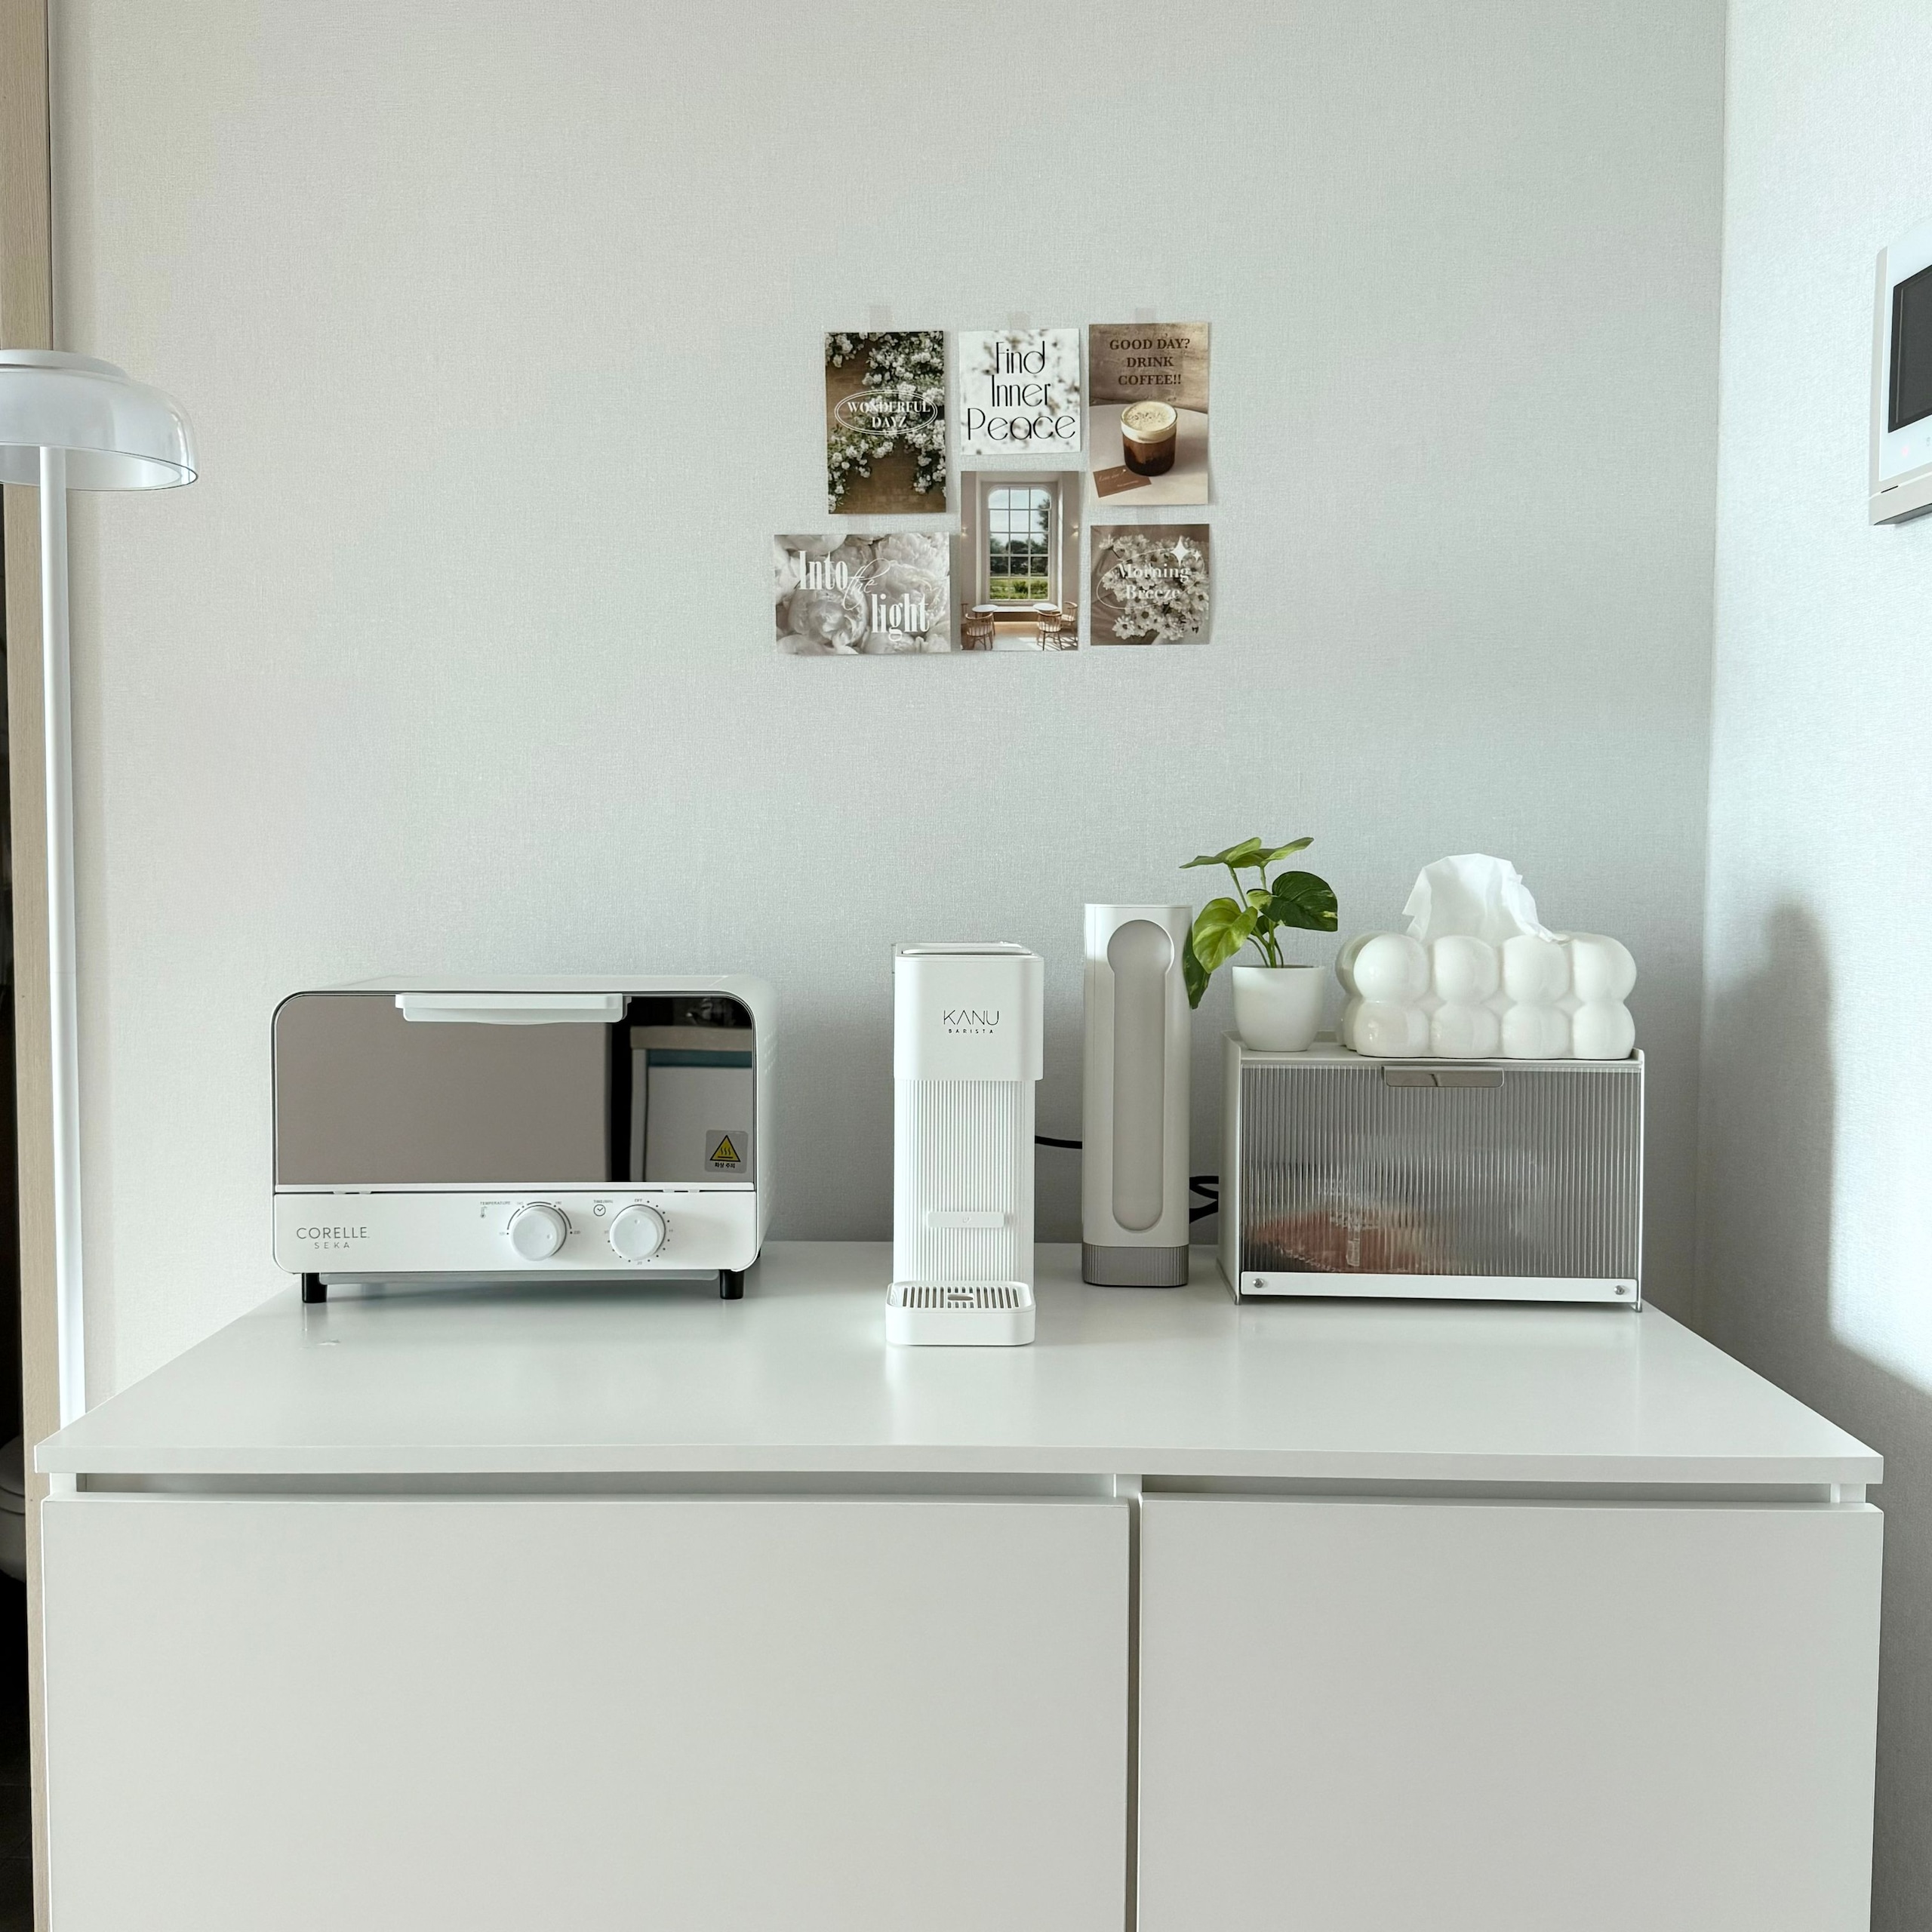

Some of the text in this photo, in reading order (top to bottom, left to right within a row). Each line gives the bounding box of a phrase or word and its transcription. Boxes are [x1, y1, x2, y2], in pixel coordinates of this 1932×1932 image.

[1109, 338, 1190, 350] GOOD DAY?
[995, 340, 1045, 374] Find
[1127, 356, 1174, 368] DRINK
[1118, 374, 1182, 386] COFFEE!!
[992, 374, 1051, 407] Inner
[847, 401, 931, 414] WONDERFUL
[968, 408, 1075, 441] Peace
[798, 550, 848, 590] Into
[1118, 563, 1191, 583] Morning
[843, 558, 891, 611] the
[1126, 584, 1181, 600] Breeze
[871, 593, 930, 641] light
[943, 1010, 999, 1026] KANU
[296, 1226, 368, 1239] CORELLE
